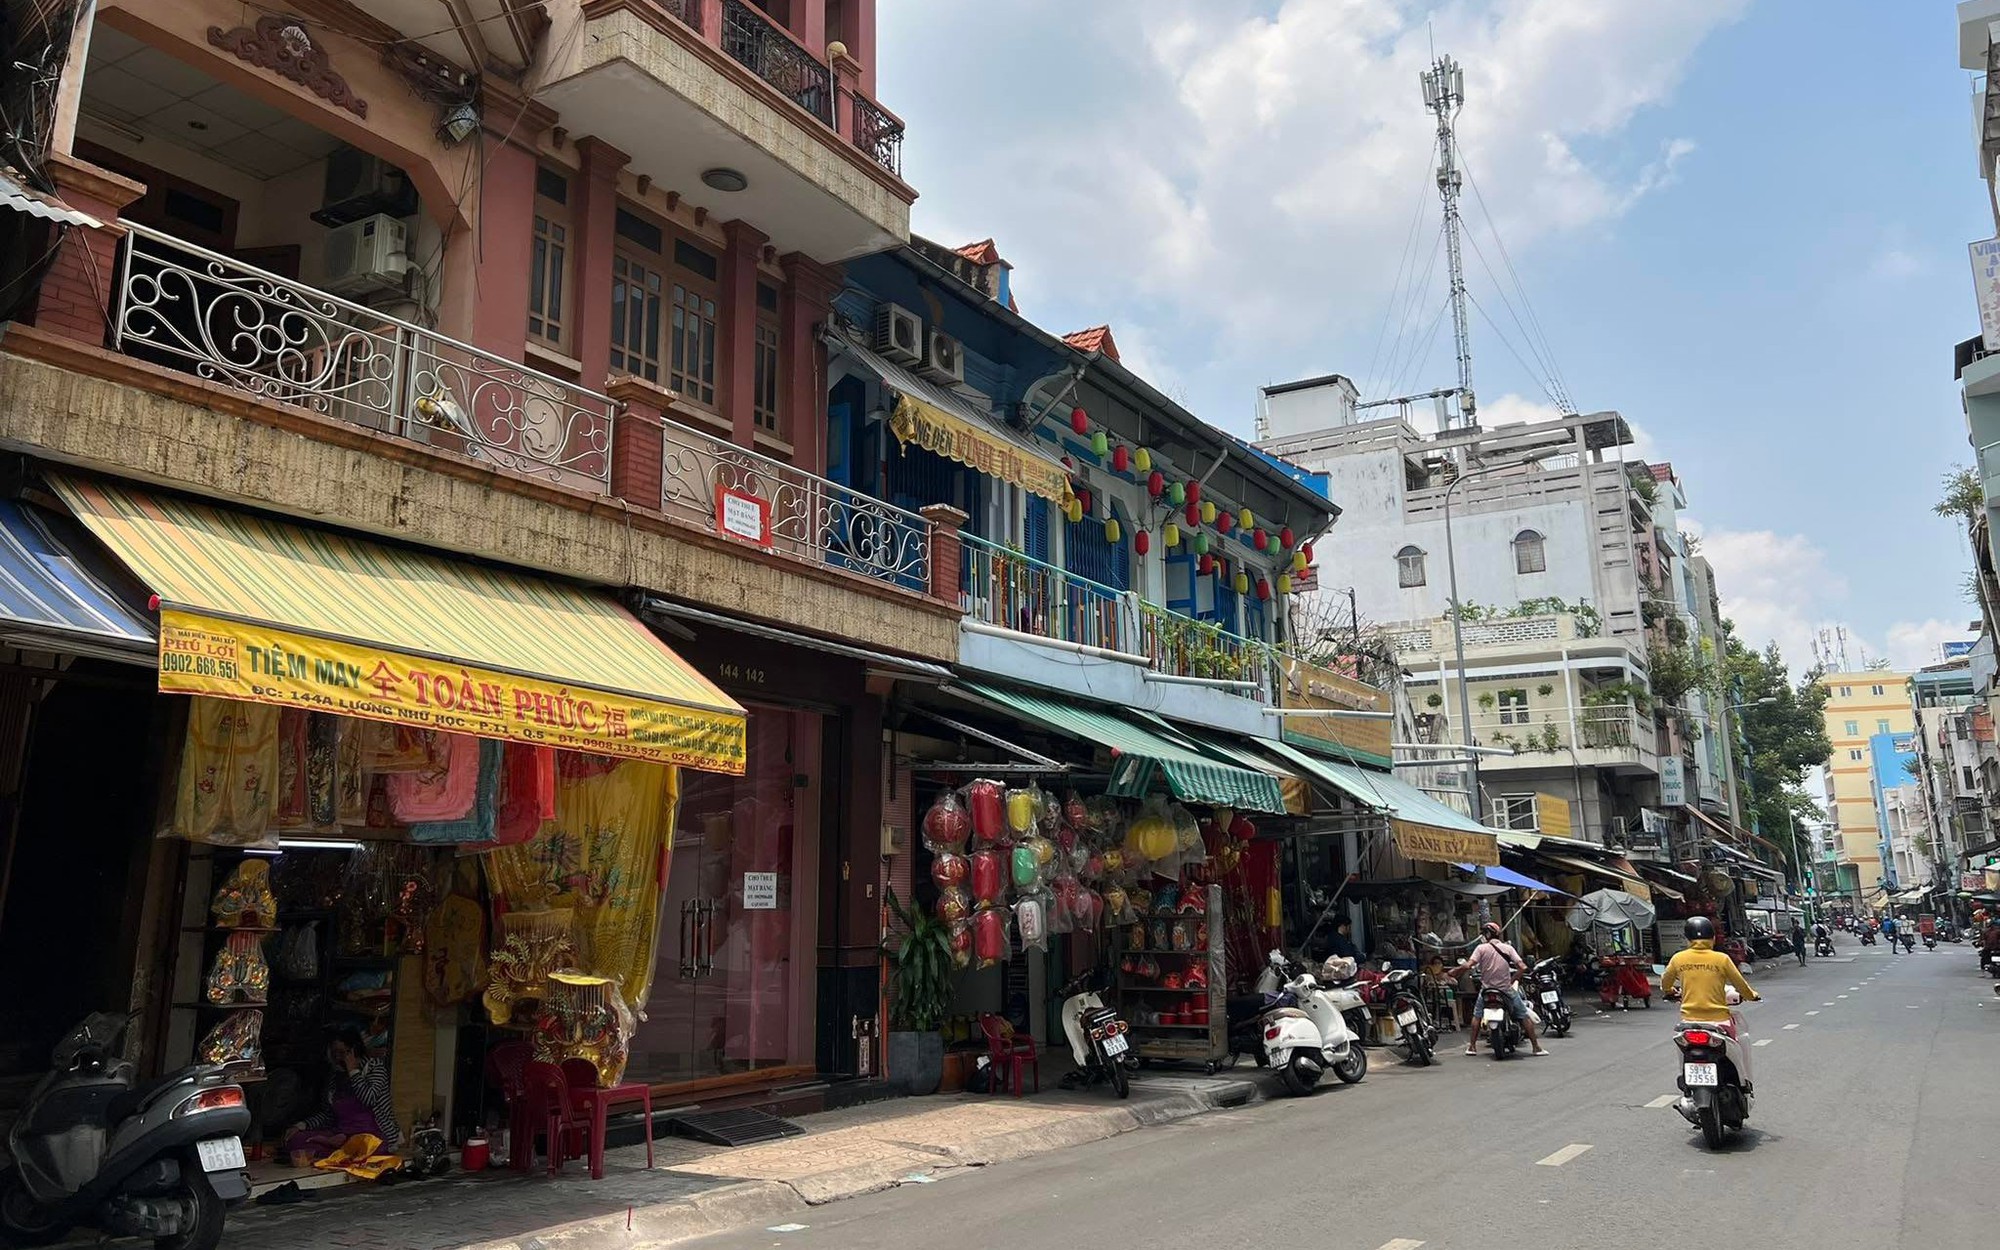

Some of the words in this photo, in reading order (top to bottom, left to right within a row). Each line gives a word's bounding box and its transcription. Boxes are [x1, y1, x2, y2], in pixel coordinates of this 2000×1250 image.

[163, 652, 237, 680] 0902.668.551
[164, 637, 200, 652] PHÚ
[207, 644, 235, 659] LỢI
[246, 643, 308, 682] TIỆM
[315, 658, 362, 689] MAY
[366, 660, 403, 703] 全
[720, 663, 738, 679] 144
[745, 667, 764, 683] 142
[252, 685, 282, 697] ĐC:
[291, 691, 333, 706] 144A
[339, 698, 393, 715] LƯƠNG
[435, 714, 465, 728] HỌC
[479, 721, 509, 734] P.11
[523, 728, 545, 739] Q.5
[407, 668, 503, 719] TOÀN
[512, 687, 599, 735] PHÚC
[601, 704, 628, 740] 福
